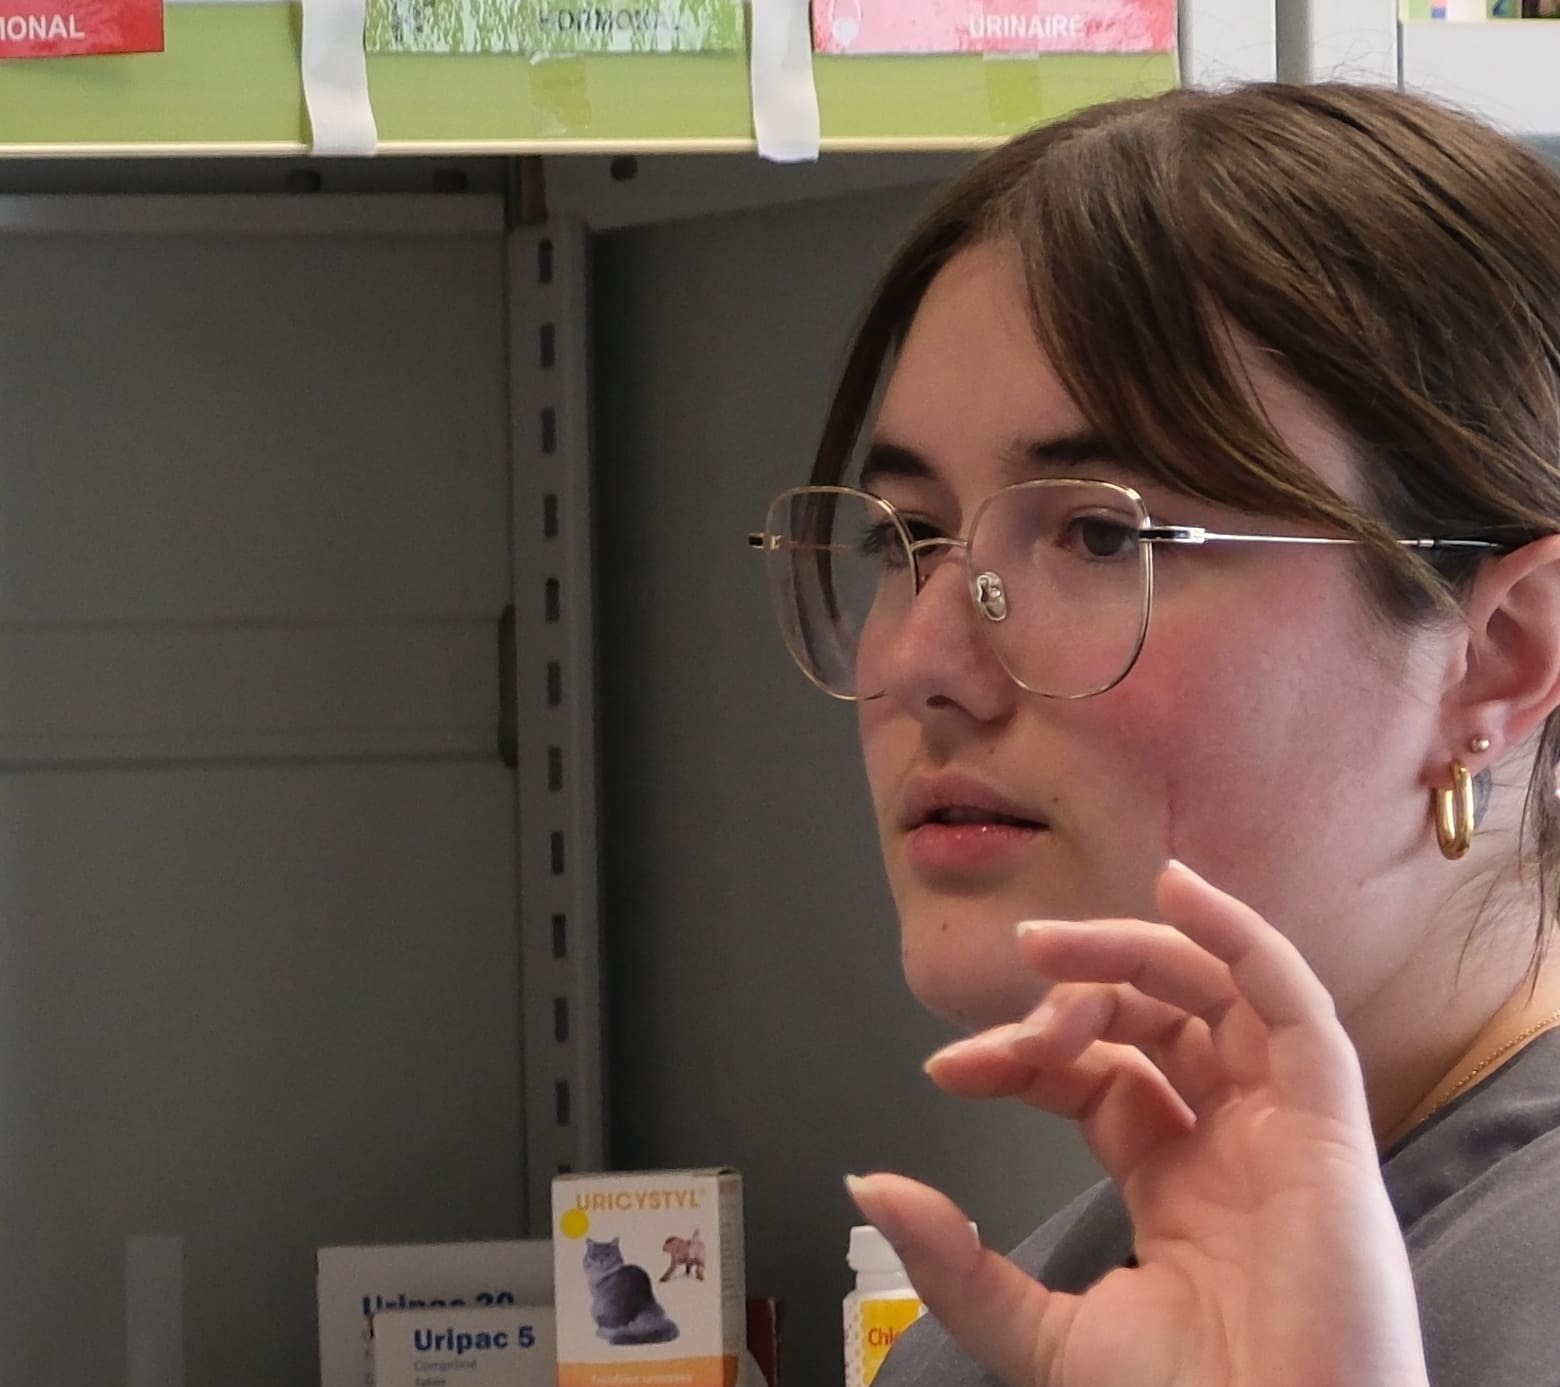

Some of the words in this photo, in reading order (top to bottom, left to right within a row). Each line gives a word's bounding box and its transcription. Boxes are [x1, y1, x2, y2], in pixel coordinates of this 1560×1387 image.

[967, 12, 1084, 42] URINAIRE
[575, 1188, 702, 1212] URICYSTYL
[413, 1328, 509, 1355] Uripac
[518, 1325, 536, 1349] 5
